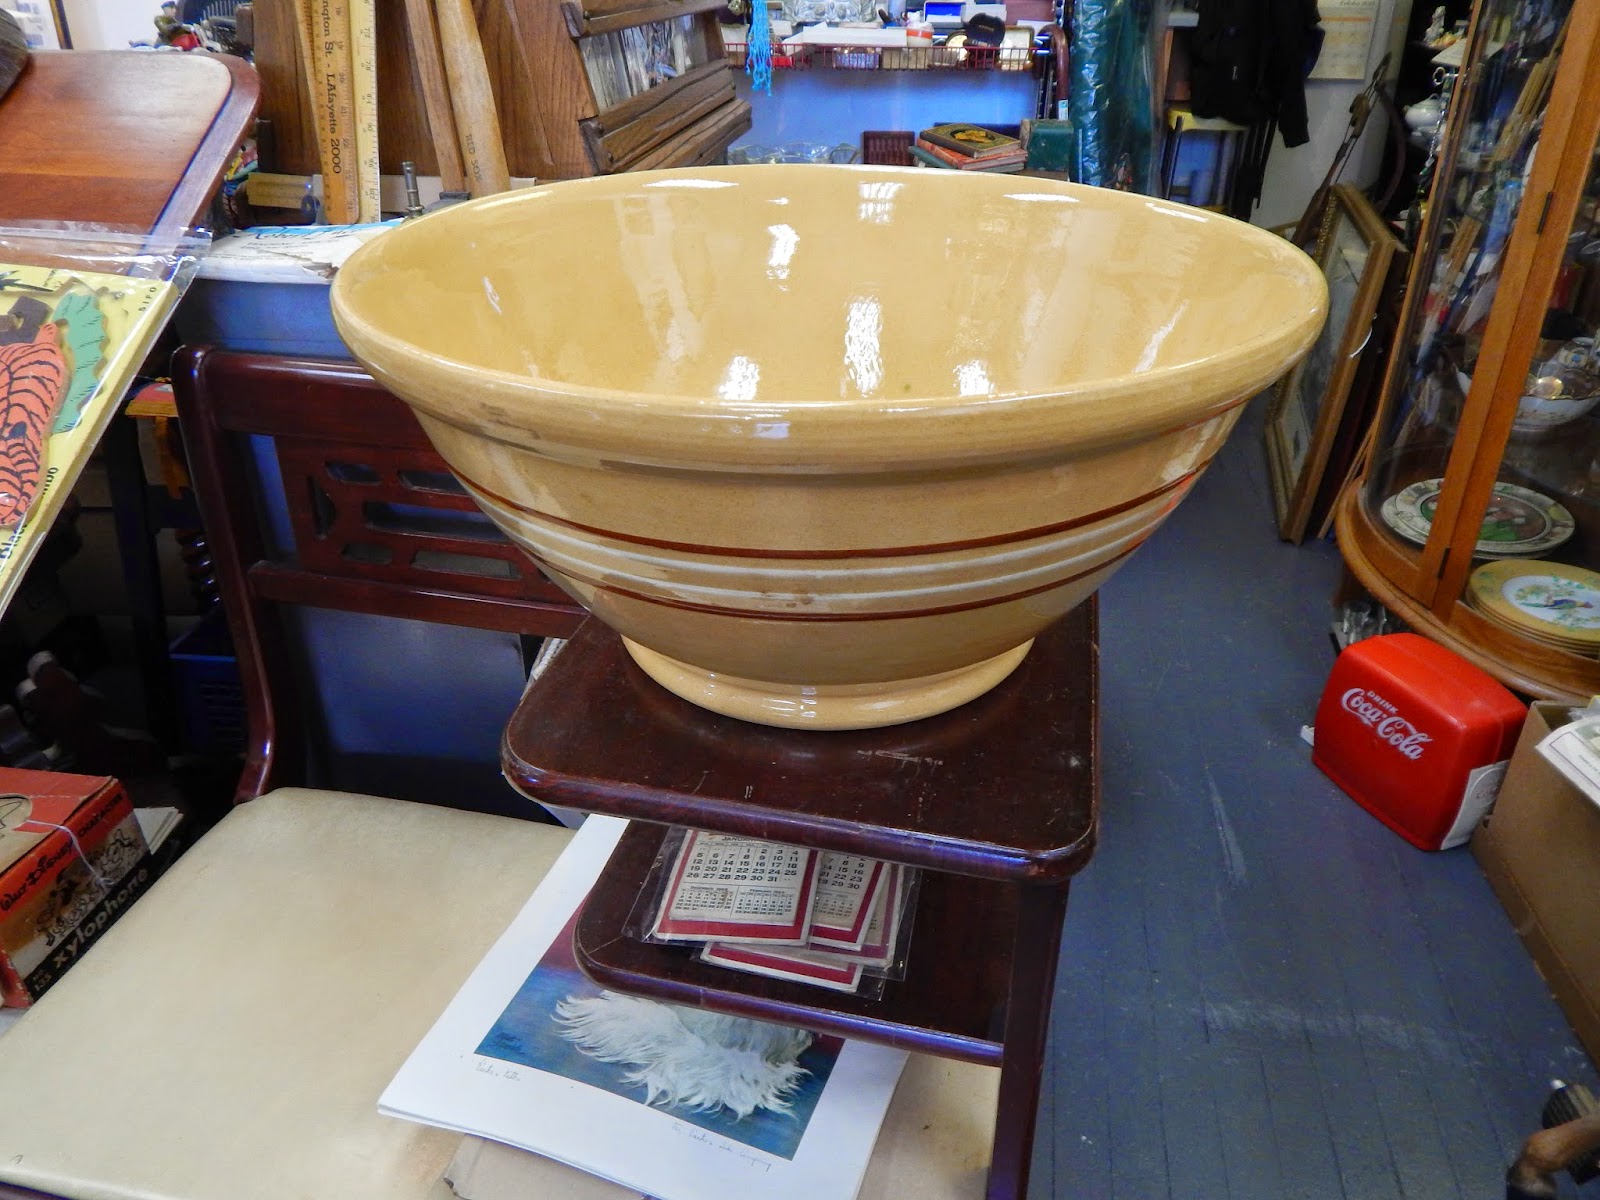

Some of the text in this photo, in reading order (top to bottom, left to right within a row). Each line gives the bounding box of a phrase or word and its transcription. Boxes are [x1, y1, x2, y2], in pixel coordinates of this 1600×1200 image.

[324, 41, 334, 57] St.
[326, 73, 337, 134] LAfayette
[330, 138, 342, 174] 2000
[465, 134, 483, 182] RED SOX
[1366, 690, 1399, 715] DRINK
[847, 882, 860, 890] 30
